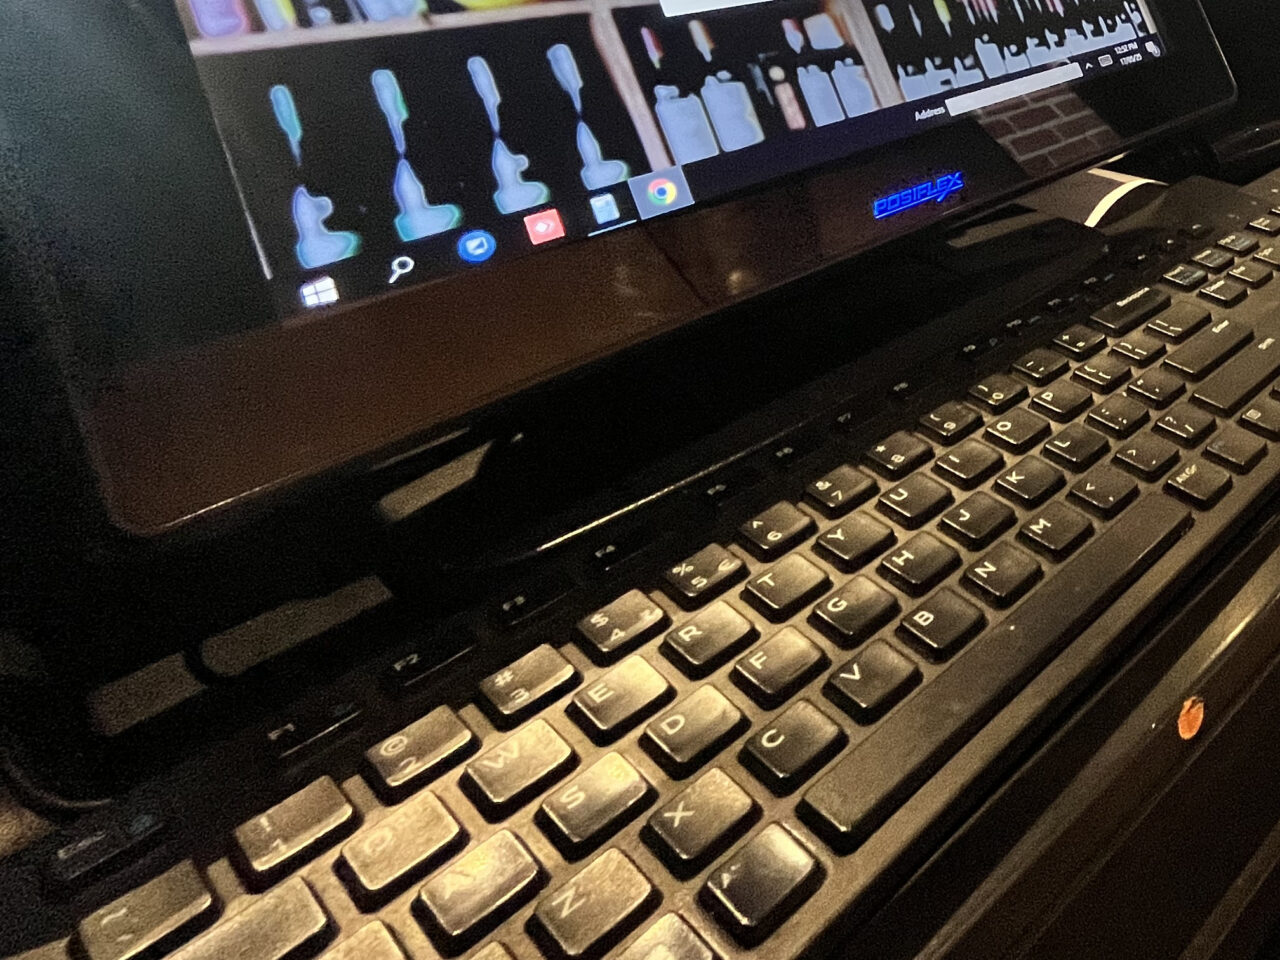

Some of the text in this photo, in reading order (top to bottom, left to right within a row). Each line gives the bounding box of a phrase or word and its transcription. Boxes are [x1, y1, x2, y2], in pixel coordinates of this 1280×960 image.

[914, 105, 946, 121] Address
[872, 170, 965, 218] POSIFLEX
[1006, 470, 1025, 484] K
[890, 488, 909, 501] U
[1029, 517, 1052, 535] M
[826, 528, 845, 542] Y
[891, 549, 914, 566] H
[672, 562, 694, 577] %
[974, 560, 997, 578] N
[690, 575, 708, 589] 5
[756, 572, 777, 588] T
[826, 596, 848, 613] G
[589, 612, 610, 628] $
[912, 610, 935, 627] B
[677, 624, 704, 642] R
[748, 650, 769, 671] F
[493, 670, 515, 687] #
[839, 663, 864, 683] V
[510, 688, 531, 705] 3
[587, 683, 615, 704] E
[660, 713, 686, 736] D
[379, 734, 408, 754] @
[761, 728, 786, 748] C
[559, 786, 586, 810] S
[662, 801, 696, 828] X
